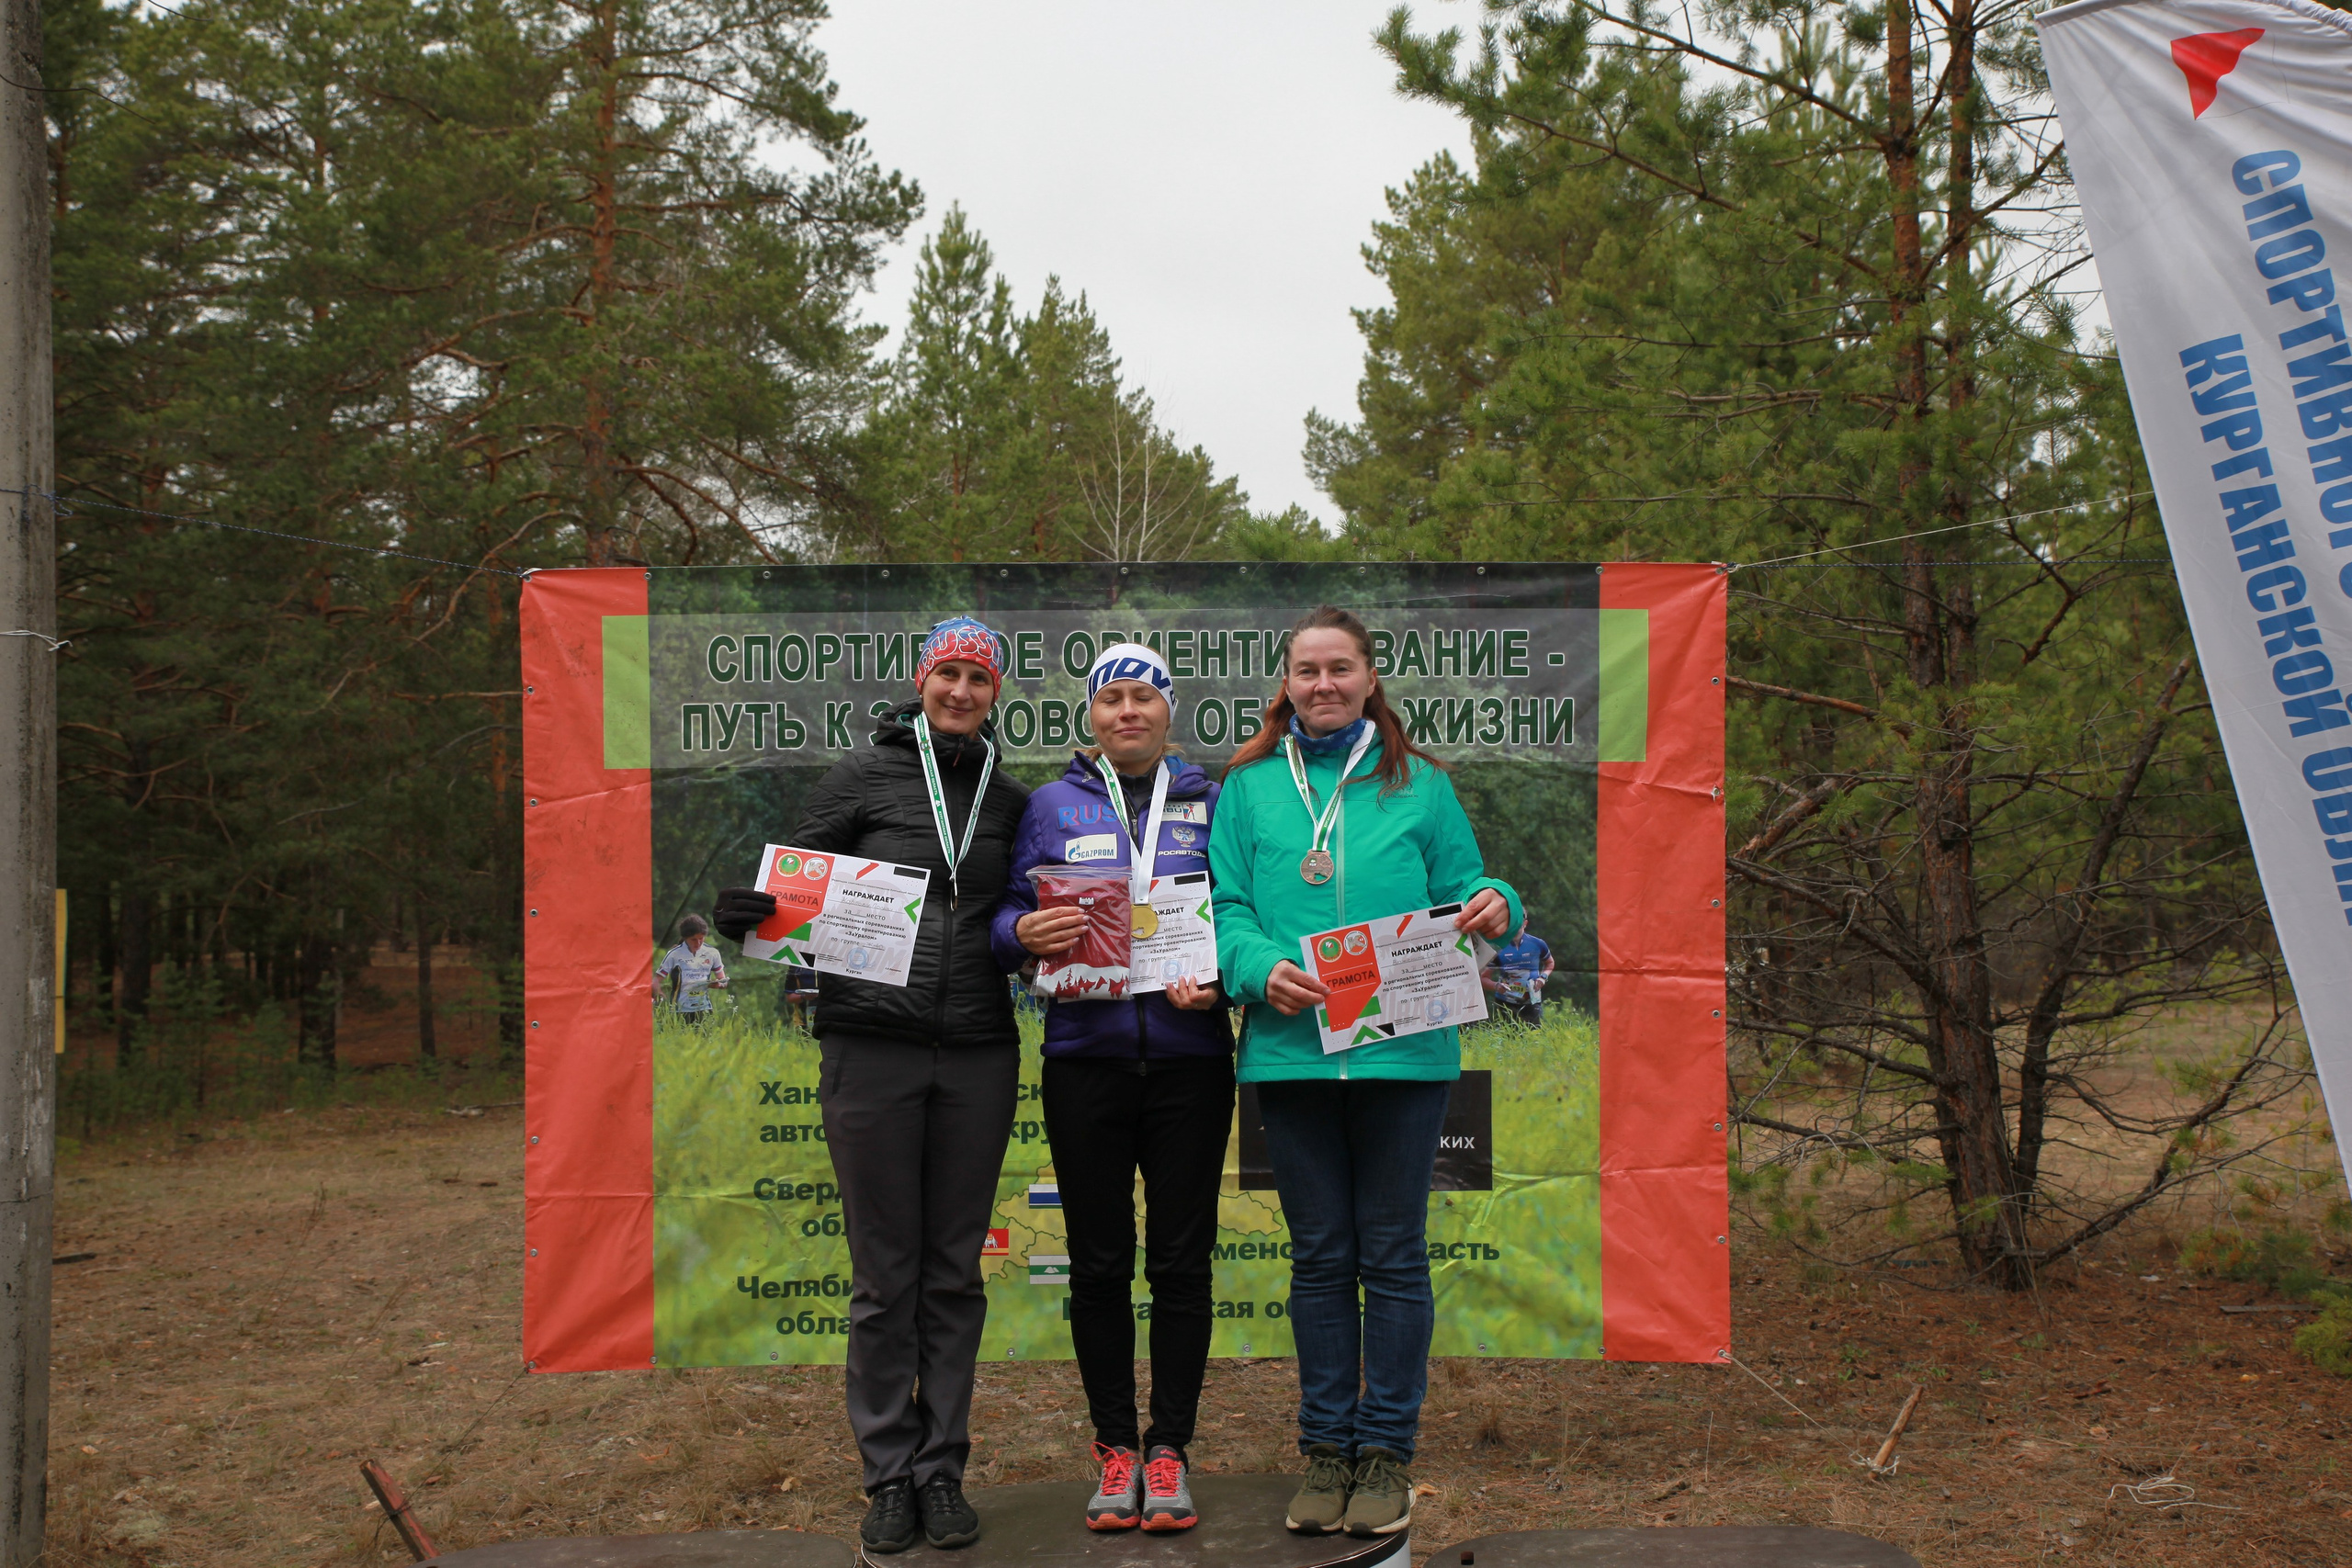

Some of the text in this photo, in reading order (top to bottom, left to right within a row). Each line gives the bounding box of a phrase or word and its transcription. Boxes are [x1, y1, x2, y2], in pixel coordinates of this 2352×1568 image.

[2232, 150, 2352, 602] СПОРТИВН
[707, 632, 1045, 682] СПОРТИЕ
[1063, 629, 1530, 679] ОЕНТИВАНИЕ
[918, 627, 1004, 682] RUSSI
[682, 702, 807, 750] ПУТЬ
[826, 700, 854, 749] К
[1402, 697, 1574, 745] ЖИЗНИ
[842, 890, 894, 903] НАГРАЖДАЕТ
[1131, 936, 1164, 944] егиональных
[1392, 942, 1442, 957] НАГРАЖДАЕТ
[1326, 970, 1376, 987] ГРАМОТА
